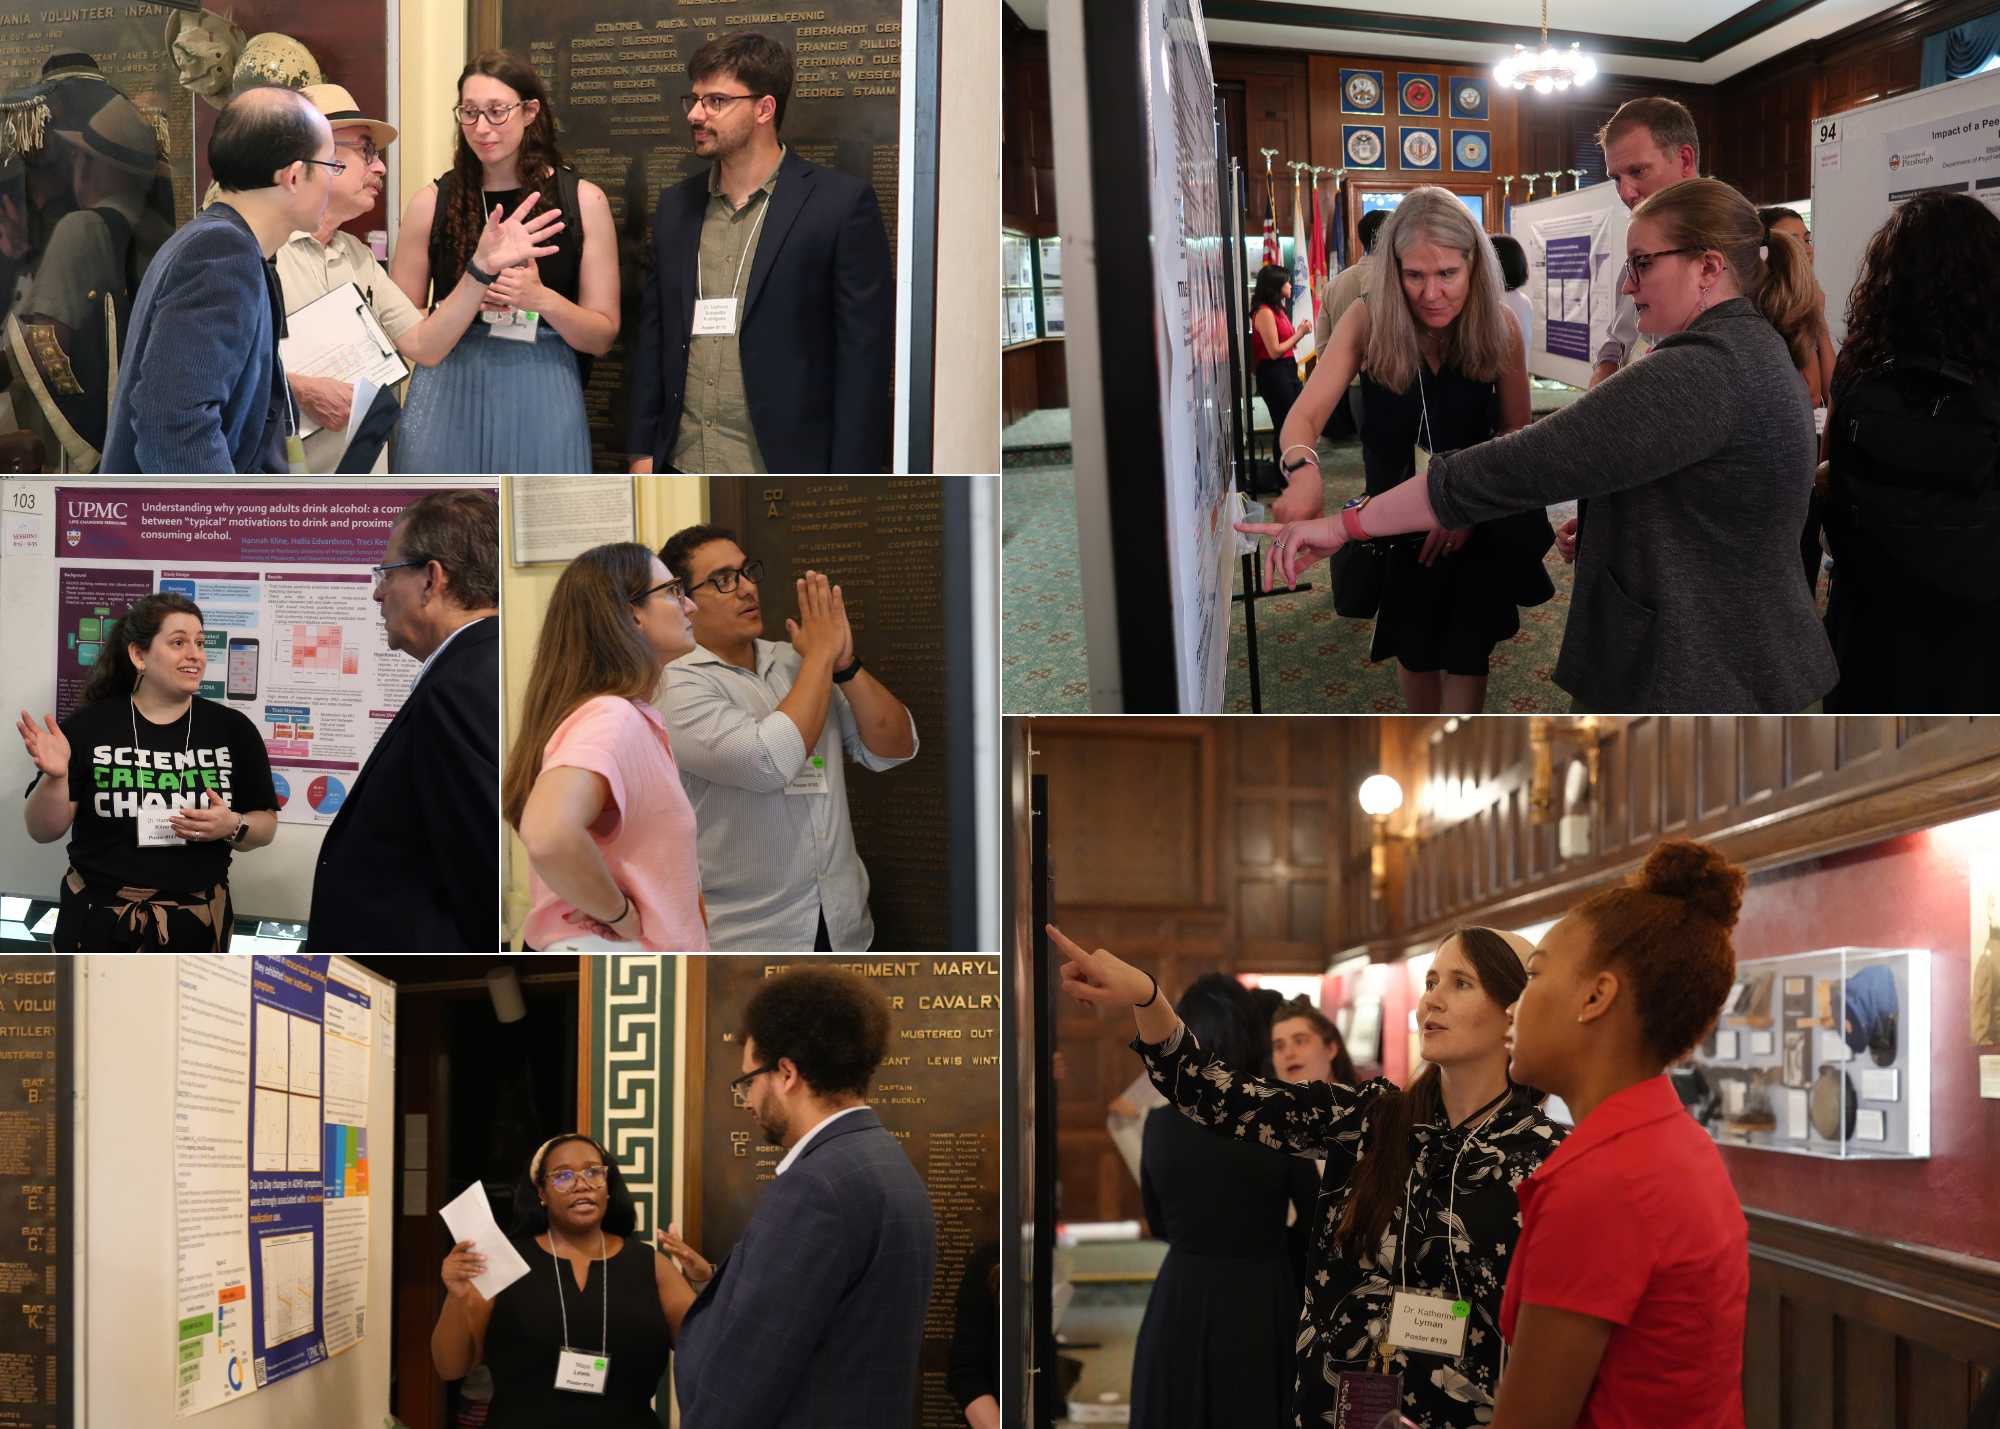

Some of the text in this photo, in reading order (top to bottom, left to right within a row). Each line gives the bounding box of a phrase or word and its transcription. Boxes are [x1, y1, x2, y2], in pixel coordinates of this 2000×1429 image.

[40, 7, 114, 23] VOLUNTEER
[595, 21, 643, 33] COLONEL
[693, 17, 717, 27] VON
[797, 24, 868, 36] EBERHARDT
[571, 37, 615, 49] FRANCIS
[621, 35, 674, 46] BLESSING
[797, 41, 848, 51] FRANCIS
[797, 56, 863, 66] FERDINAND
[613, 79, 656, 89] BECKER
[796, 85, 896, 98] GEORGE STAMM
[1820, 123, 1837, 143] 94
[1932, 127, 1960, 141] Impact
[1963, 121, 1973, 133] of
[1974, 123, 1980, 131] a
[12, 493, 36, 509] 103
[68, 501, 128, 519] UPMC
[142, 502, 212, 514] Understanding
[214, 503, 234, 514] why
[237, 504, 267, 515] young
[269, 503, 300, 514] adults
[302, 503, 328, 514] drink
[330, 504, 370, 514] alcohol:
[372, 506, 379, 514] a
[141, 515, 182, 526] between
[229, 516, 287, 527] motivations
[289, 519, 300, 527] to
[302, 518, 328, 528] drink
[330, 518, 350, 528] and
[141, 530, 232, 541] consuming alcohol.
[93, 745, 232, 770] SCIENCE
[93, 766, 232, 790] CREATES
[918, 994, 1000, 1011] CAVALRY
[900, 1028, 994, 1040] MUSTERED OUT
[927, 1056, 962, 1066] LEWIS
[878, 1084, 913, 1092] CAPTAIN
[734, 1142, 746, 1157] G
[755, 1159, 777, 1167] JOHN
[1415, 1318, 1443, 1329] Lyman
[1405, 1332, 1429, 1342] Poster
